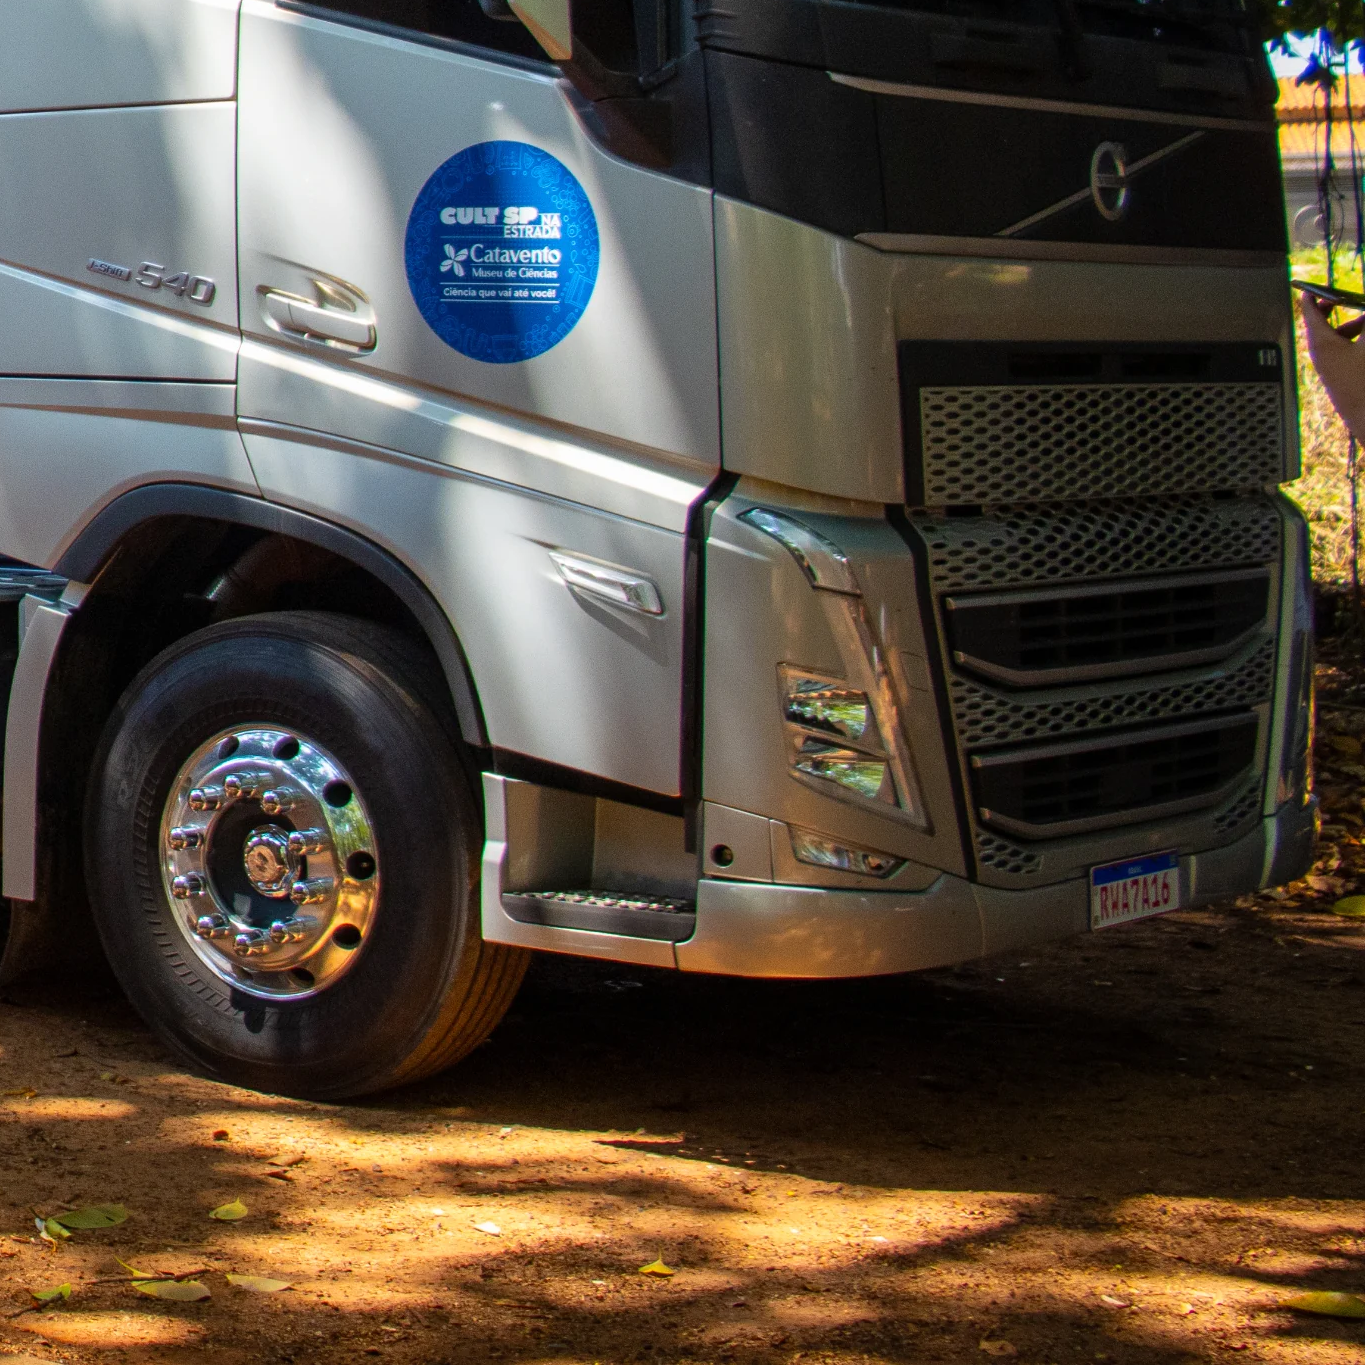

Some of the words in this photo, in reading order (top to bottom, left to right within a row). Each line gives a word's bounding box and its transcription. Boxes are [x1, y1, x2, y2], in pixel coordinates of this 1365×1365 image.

[440, 206, 500, 225] CULT
[503, 206, 539, 225] SP
[541, 213, 561, 226] NA
[503, 225, 561, 239] ESTRADA
[470, 243, 562, 264] Catavento
[471, 267, 503, 278] Museu
[505, 267, 517, 278] de
[518, 266, 558, 279] Ciências
[90, 260, 125, 278] I-Shift
[135, 261, 218, 306] 540
[443, 287, 477, 297] Ciência
[478, 289, 496, 298] que
[497, 287, 512, 297] vai
[513, 287, 529, 298] até
[530, 288, 557, 298] você!
